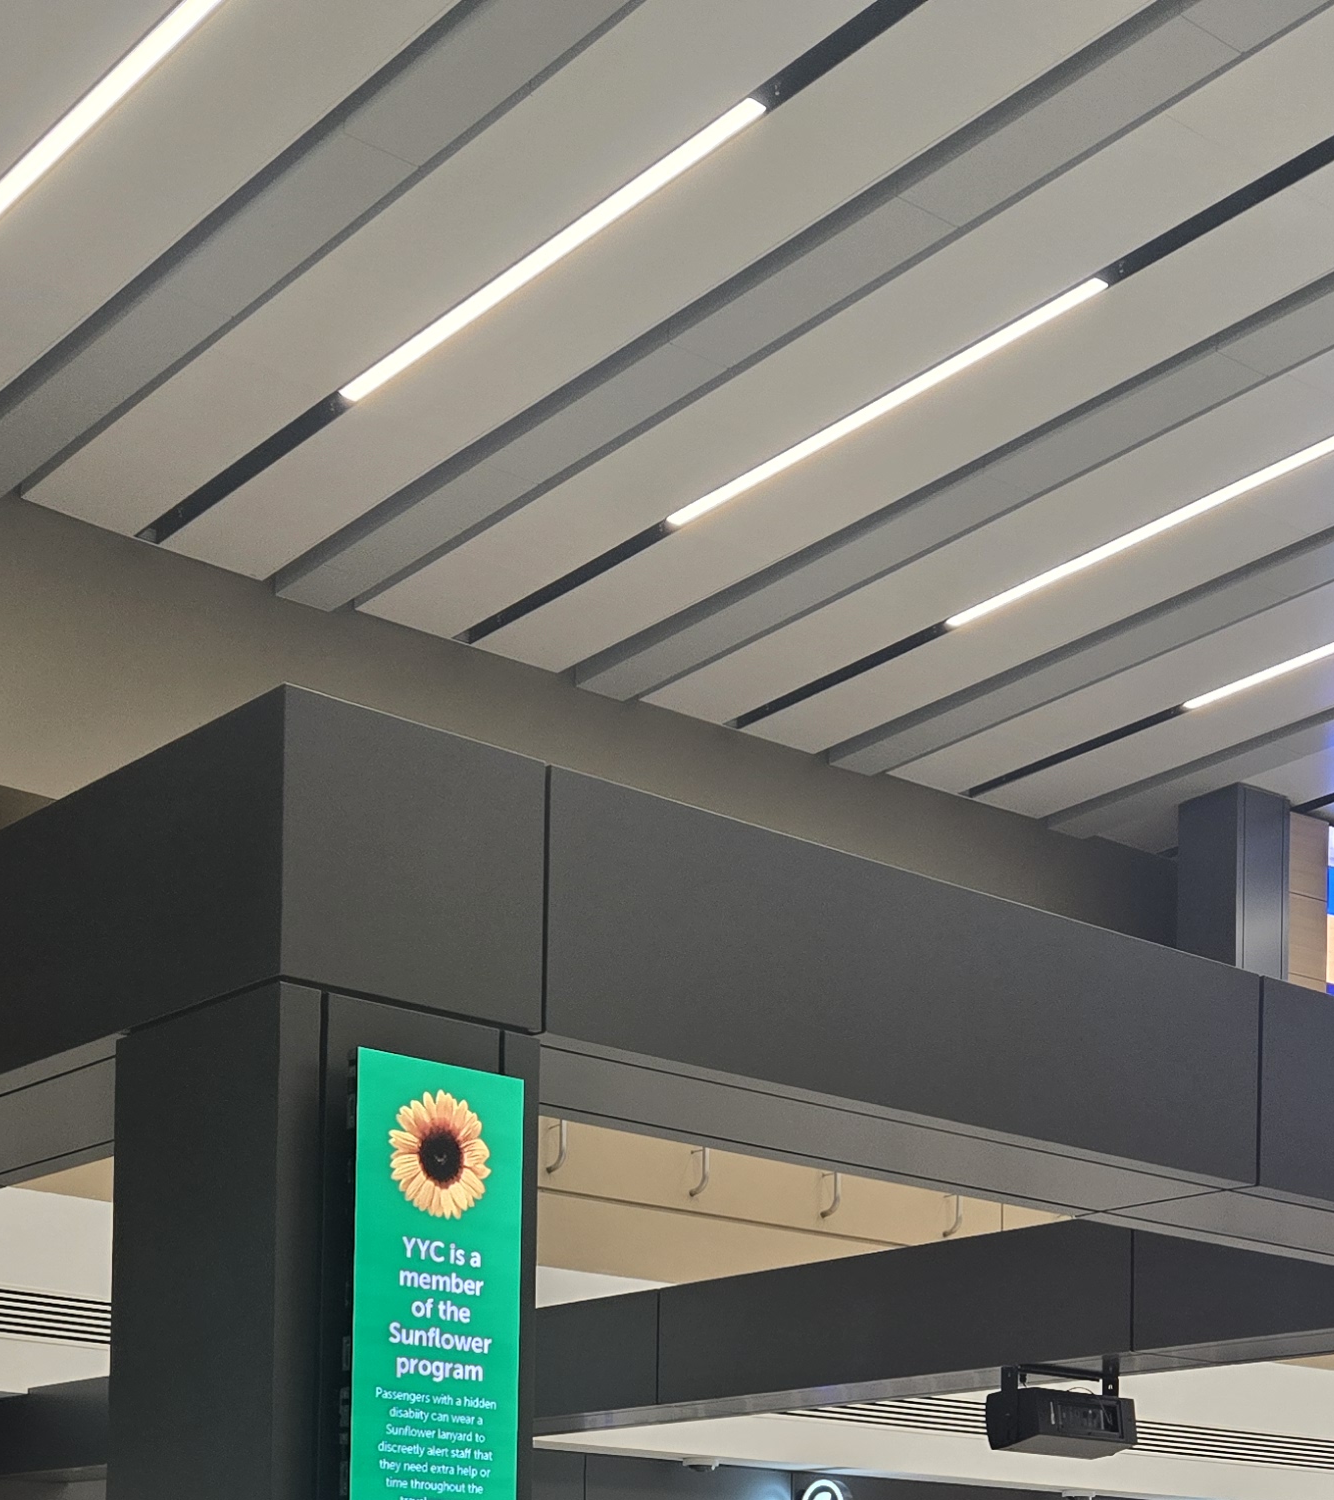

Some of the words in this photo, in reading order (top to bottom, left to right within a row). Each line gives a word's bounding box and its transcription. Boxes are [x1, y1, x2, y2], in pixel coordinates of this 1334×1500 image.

[403, 1236, 445, 1262] YYC
[450, 1244, 465, 1265] is
[470, 1251, 481, 1267] a
[400, 1270, 483, 1296] member
[412, 1299, 434, 1318] of
[438, 1301, 470, 1323] the
[389, 1322, 492, 1353] Sunflower
[396, 1357, 483, 1382] program
[375, 1387, 430, 1404] Passengers
[433, 1394, 453, 1405] with
[464, 1397, 496, 1409] hidden
[431, 1413, 449, 1422] can
[451, 1415, 475, 1425] wear
[386, 1424, 435, 1438] Sunflower
[438, 1429, 472, 1443] lanyard
[475, 1434, 485, 1443] to
[378, 1442, 425, 1457] discreetly
[427, 1446, 449, 1457] alert
[451, 1448, 471, 1458] staff
[474, 1450, 492, 1461] that
[379, 1459, 401, 1472] they
[404, 1462, 428, 1472] need
[430, 1465, 454, 1475] extra
[457, 1465, 477, 1478] help
[480, 1469, 491, 1477] or
[386, 1477, 408, 1488] time
[411, 1479, 465, 1493] throughout
[468, 1484, 483, 1494] the
